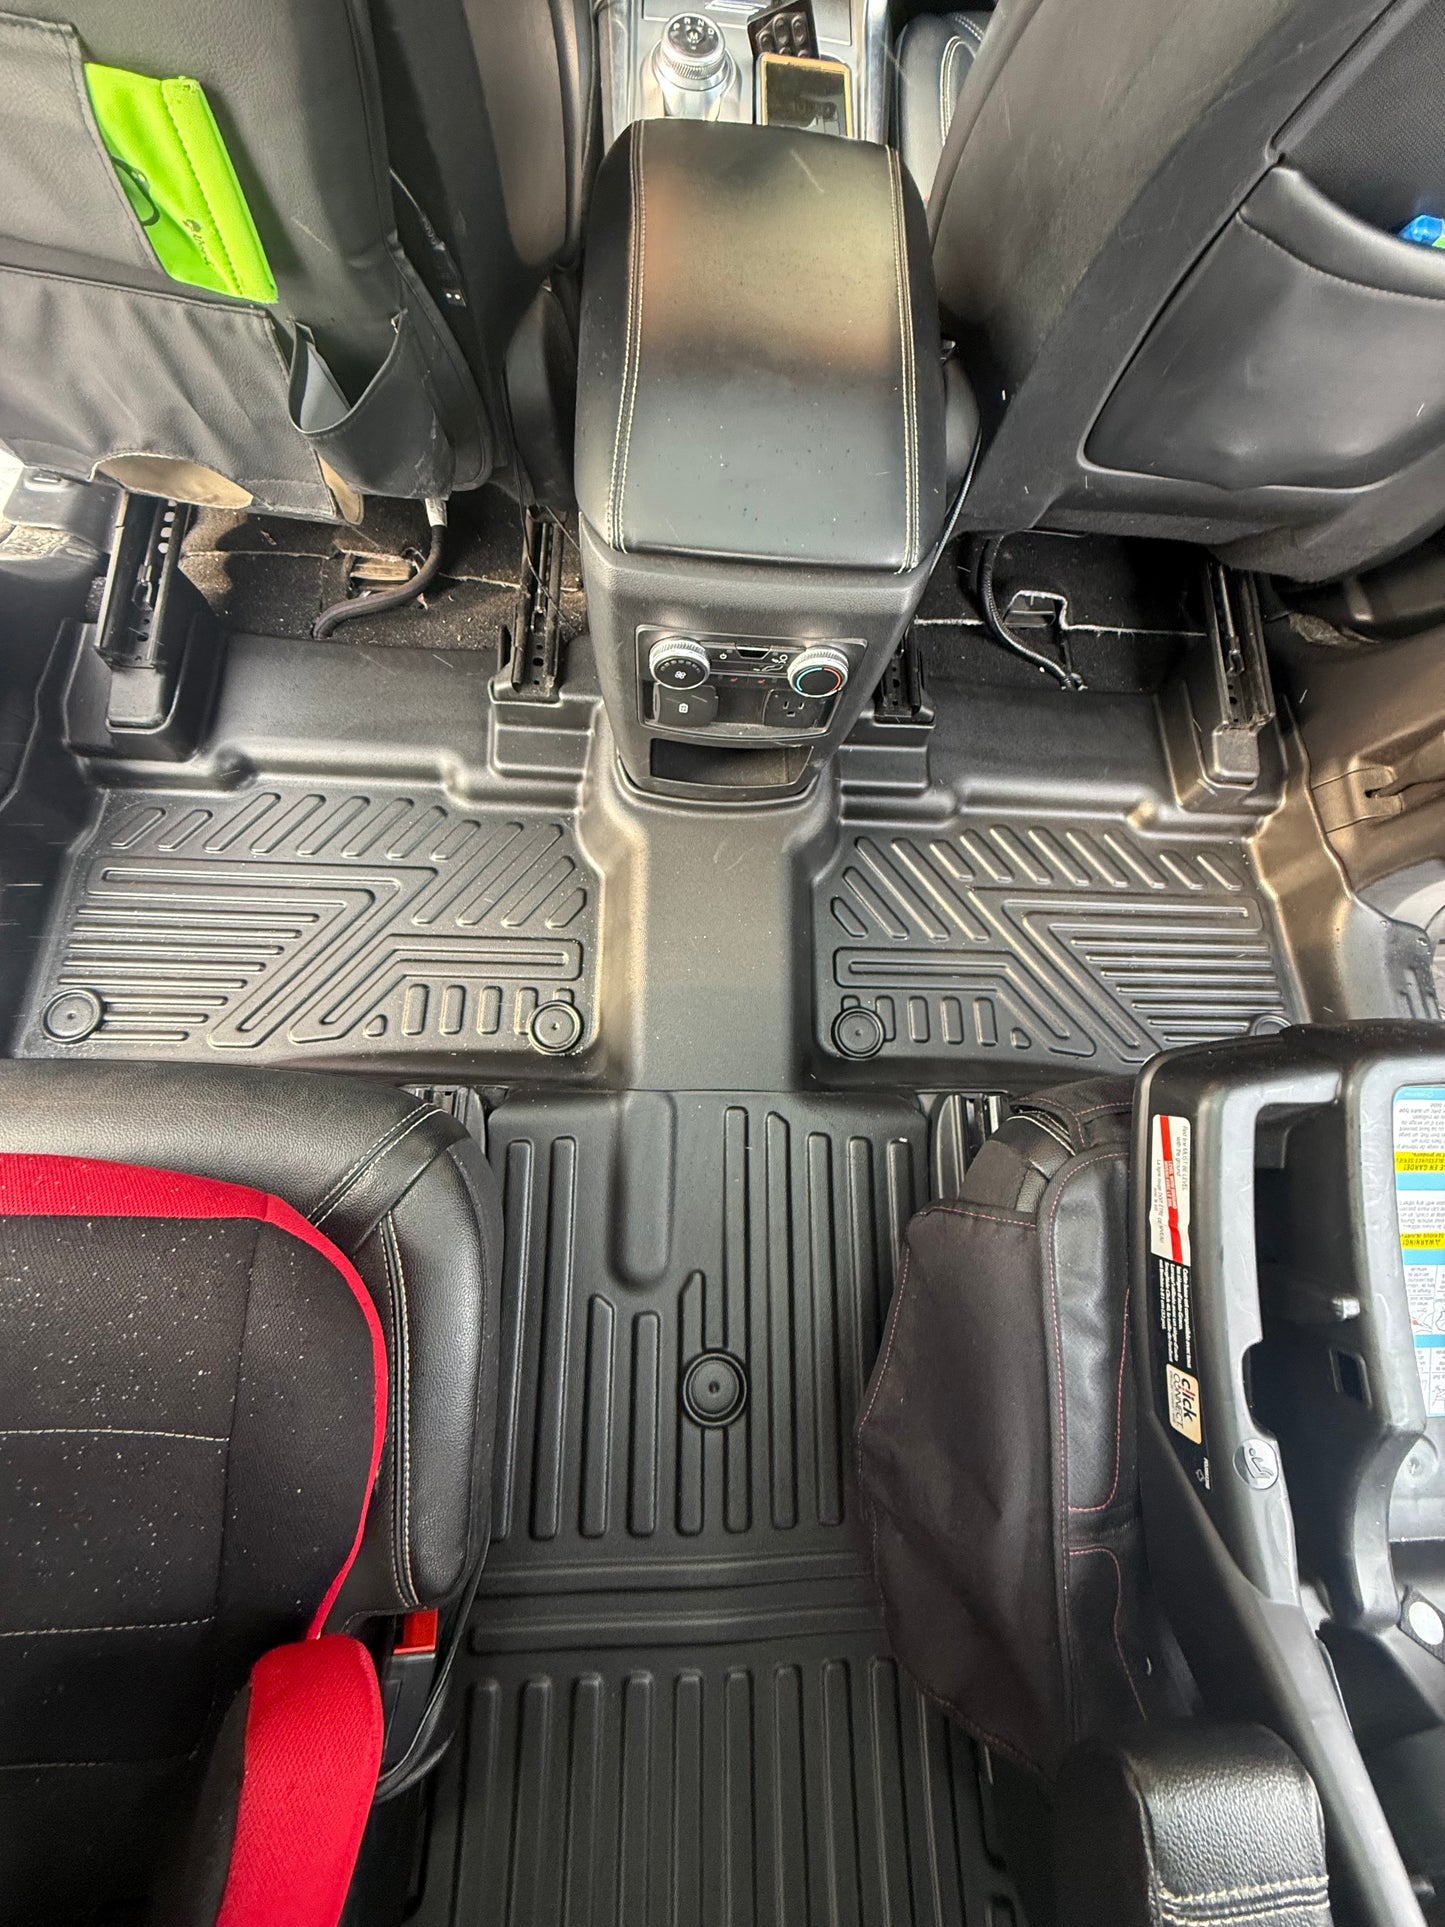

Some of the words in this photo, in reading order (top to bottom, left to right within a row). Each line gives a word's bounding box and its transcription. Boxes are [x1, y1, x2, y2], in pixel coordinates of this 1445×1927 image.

[673, 22, 680, 31] P
[698, 19, 704, 27] N
[1173, 1373, 1183, 1429] CONNECT
